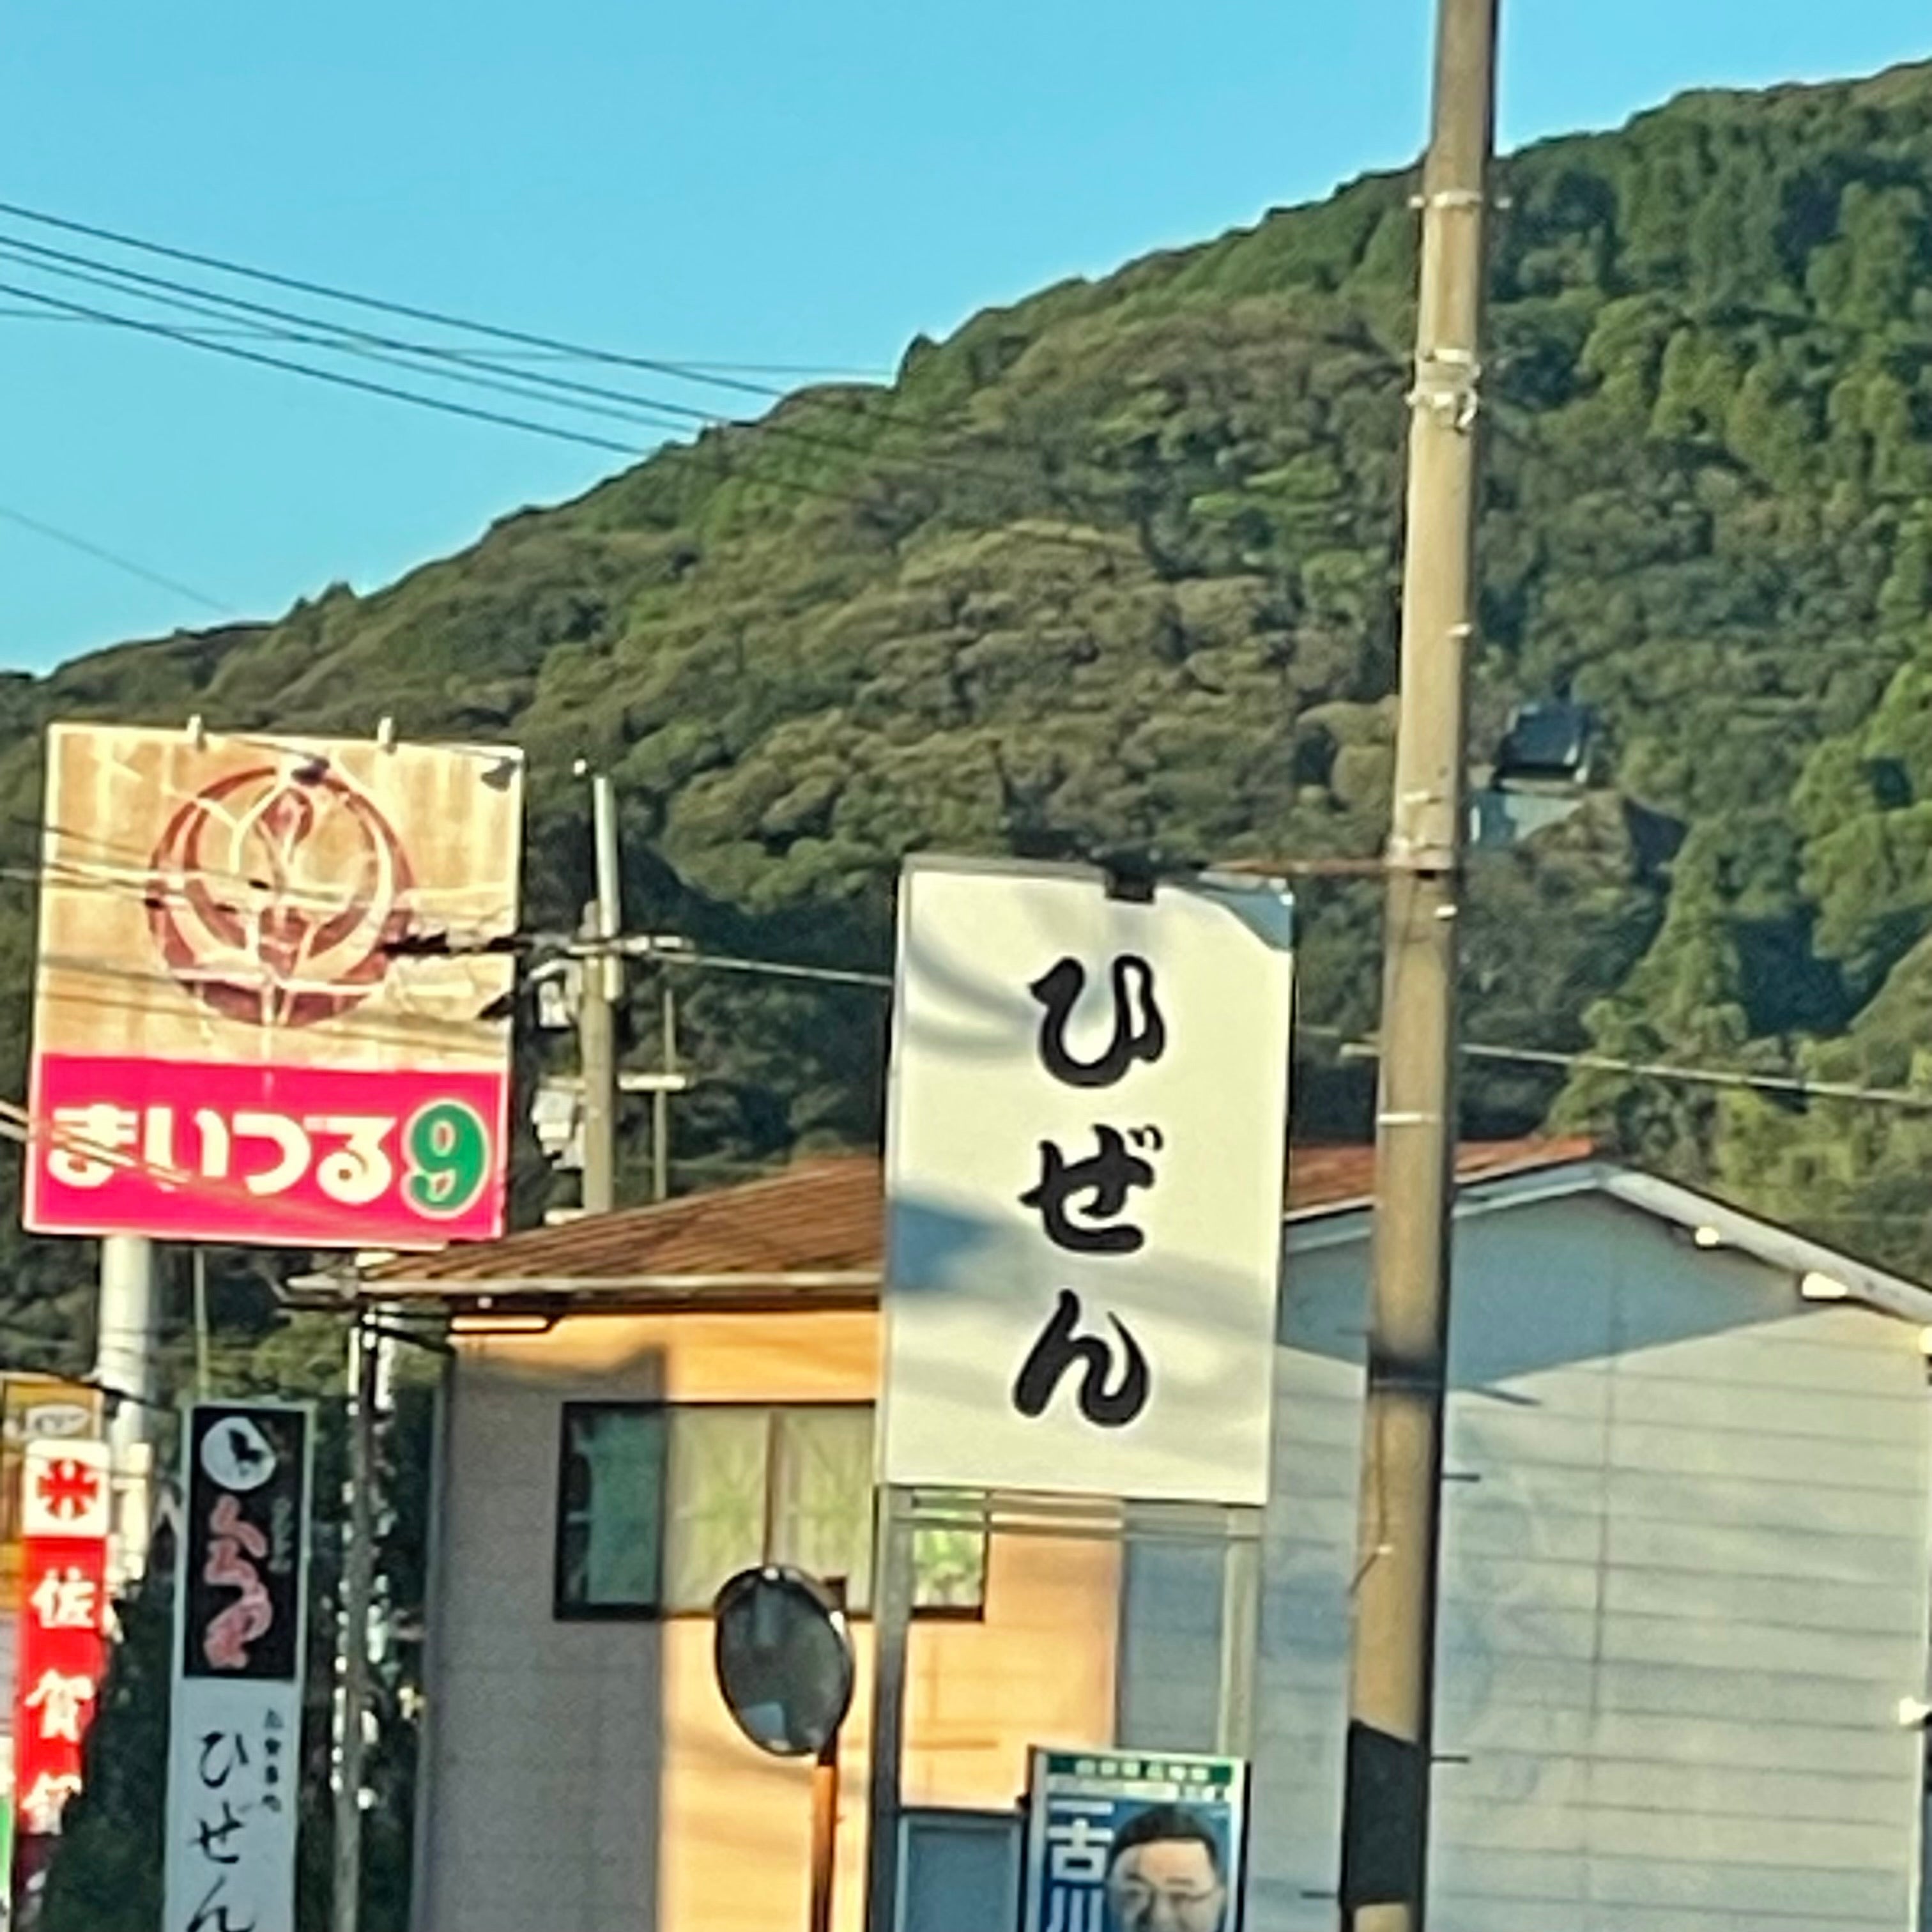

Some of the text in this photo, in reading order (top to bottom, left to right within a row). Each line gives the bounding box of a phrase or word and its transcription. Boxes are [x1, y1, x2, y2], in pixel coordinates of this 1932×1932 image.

[1013, 954, 1166, 1427] ひぜん
[23, 1567, 96, 1926] 佐賀
